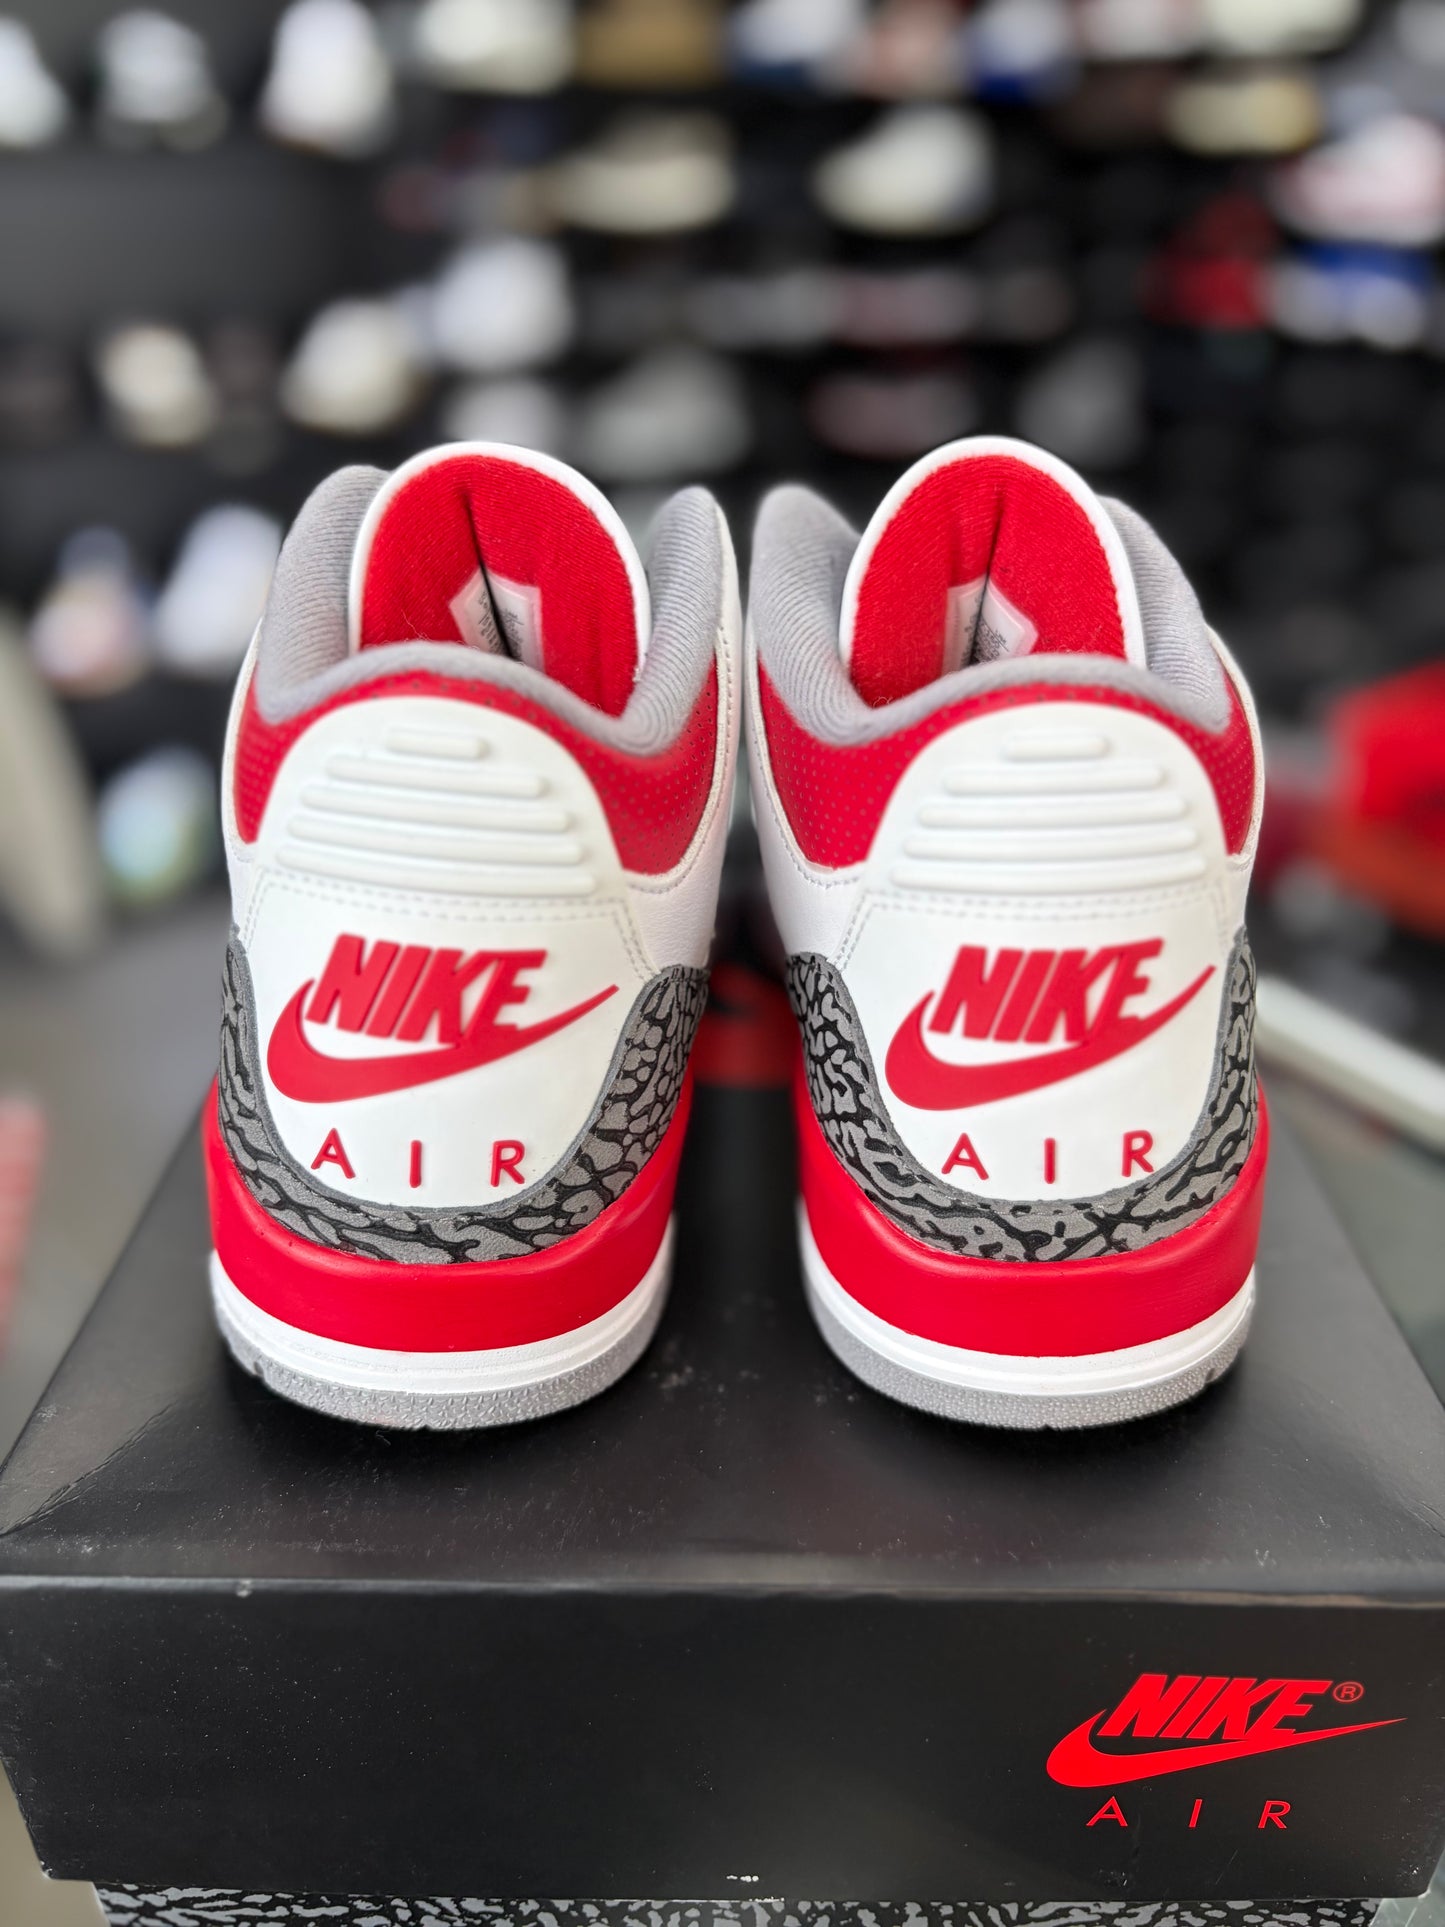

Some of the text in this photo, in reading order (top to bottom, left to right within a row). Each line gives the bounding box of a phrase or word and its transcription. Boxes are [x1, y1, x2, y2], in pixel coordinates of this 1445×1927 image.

[304, 933, 548, 1047] NIKE
[928, 937, 1164, 1044] NIKE
[310, 1128, 526, 1189] AIR
[941, 1130, 1155, 1184] AIR
[1096, 1673, 1334, 1741] NIKE
[1085, 1796, 1292, 1829] AIR
